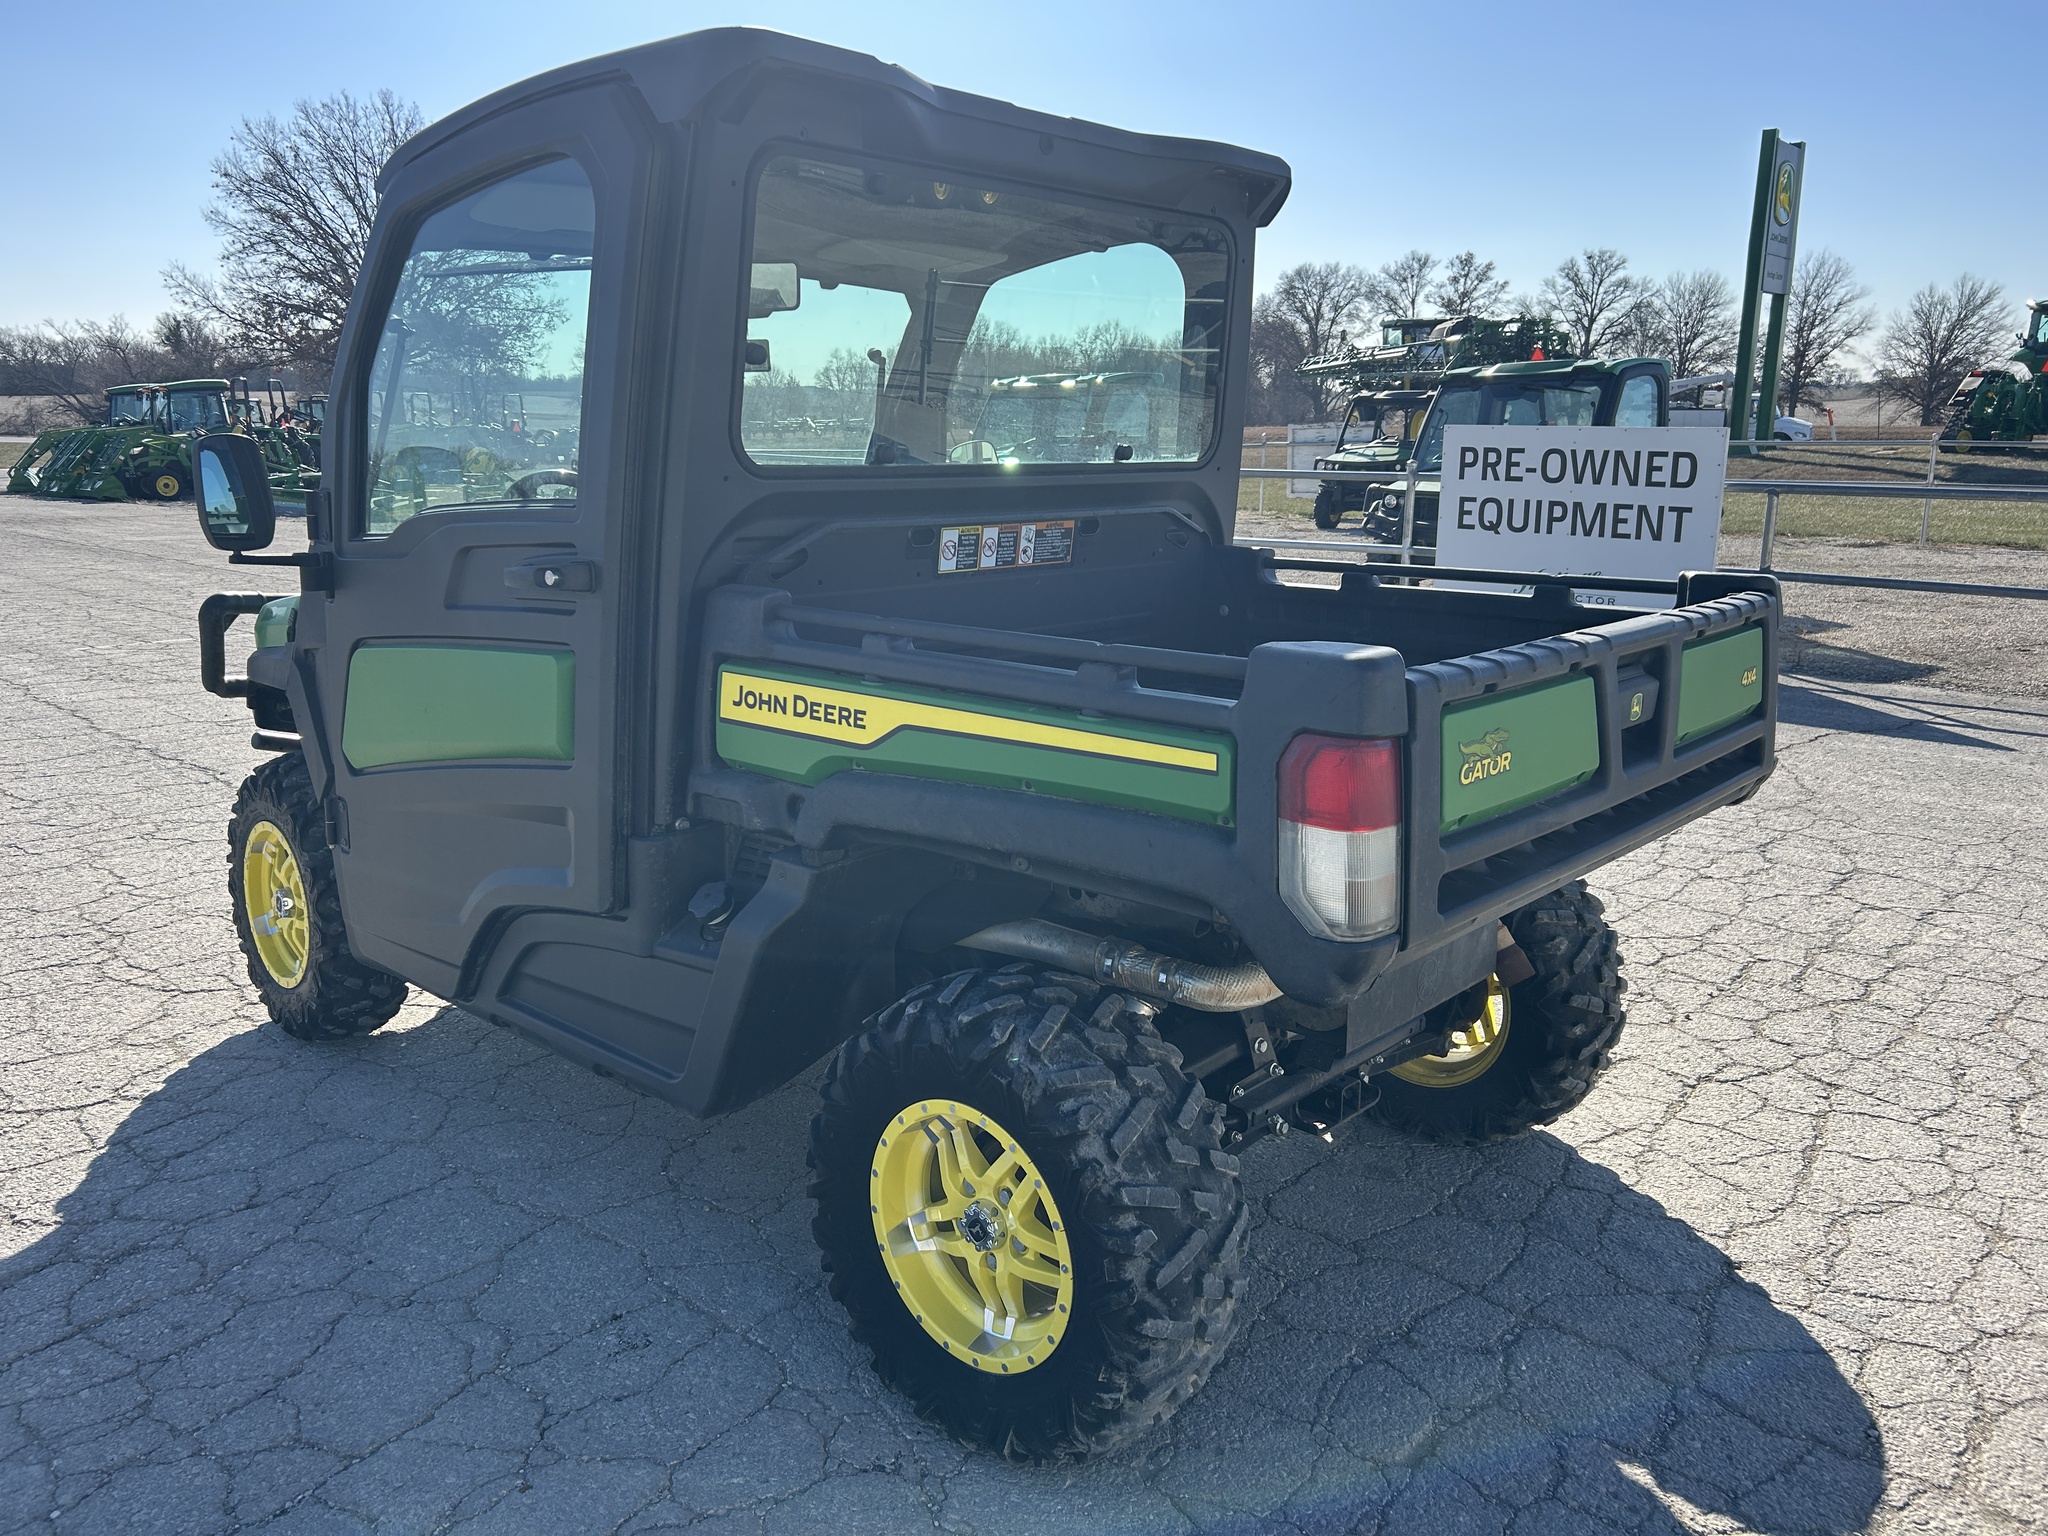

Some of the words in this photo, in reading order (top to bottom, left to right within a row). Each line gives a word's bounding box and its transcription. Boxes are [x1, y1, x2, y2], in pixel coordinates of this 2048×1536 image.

[1458, 446, 1698, 489] PRE-OWNED
[1457, 496, 1693, 543] EQUIPMENT
[1575, 594, 1616, 606] CTOR
[732, 685, 787, 715] JOHN
[793, 694, 867, 730] DEERE
[1460, 751, 1512, 785] GATOR
